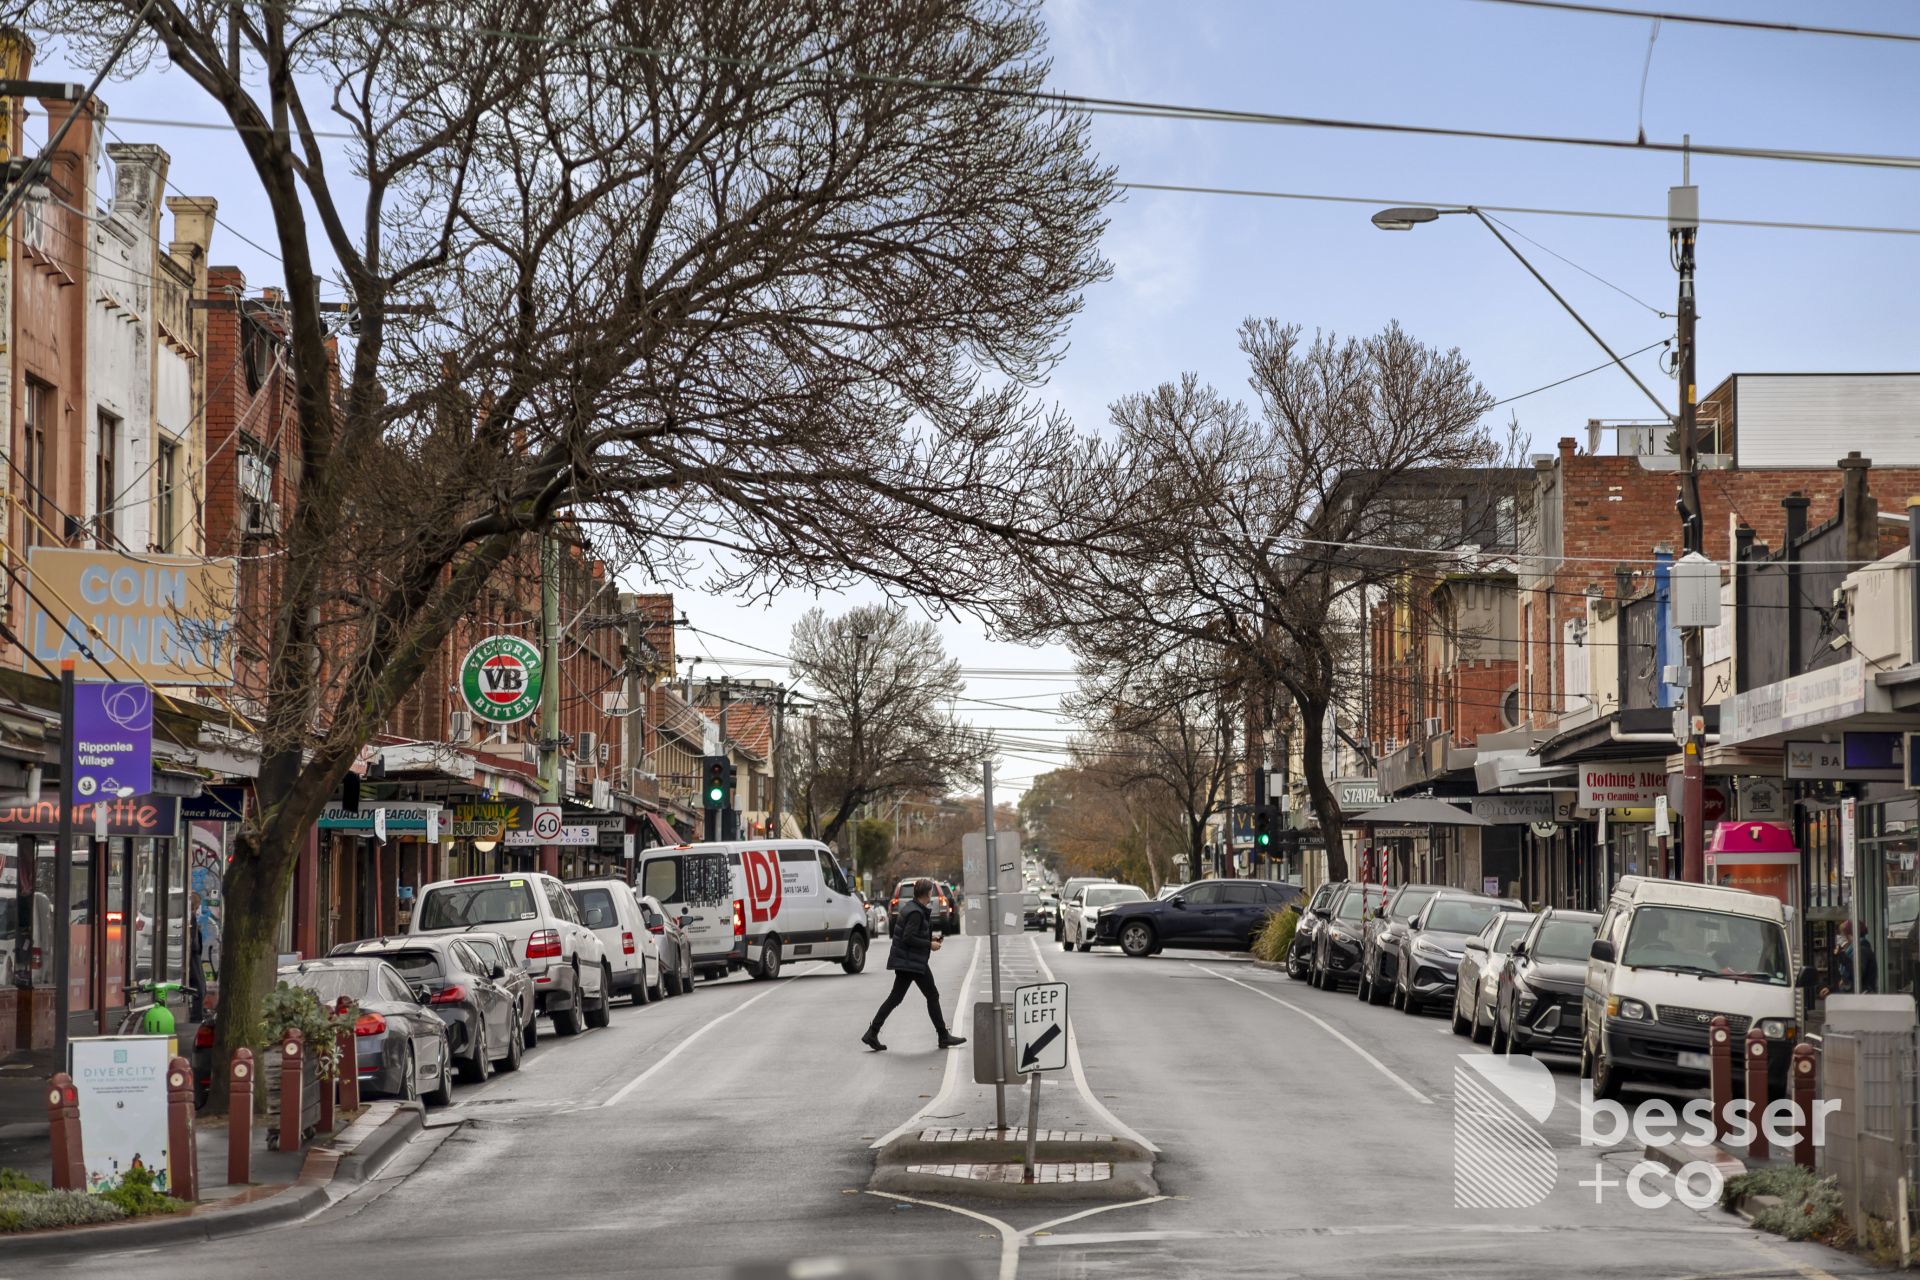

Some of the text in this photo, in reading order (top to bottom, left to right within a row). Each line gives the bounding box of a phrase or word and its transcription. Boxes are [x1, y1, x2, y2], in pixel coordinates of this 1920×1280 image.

[79, 564, 187, 608] COIN
[34, 611, 230, 667] LAUNDRY
[470, 641, 537, 669] VICTORIA
[481, 668, 522, 690] VB
[475, 696, 533, 717] BITTER
[78, 742, 134, 754] Ripponlea
[78, 756, 114, 768] Village
[1586, 772, 1636, 789] Clothing
[1592, 792, 1639, 802] Dry Cleaning
[209, 808, 231, 818] Wear
[328, 808, 373, 820] QUALITY
[1504, 807, 1532, 816] LOVE
[453, 820, 500, 836] RUITS
[538, 819, 558, 833] 60
[1023, 991, 1059, 1006] KEEP
[1024, 1008, 1057, 1024] LEFT
[83, 1066, 156, 1078] DIVERCITY
